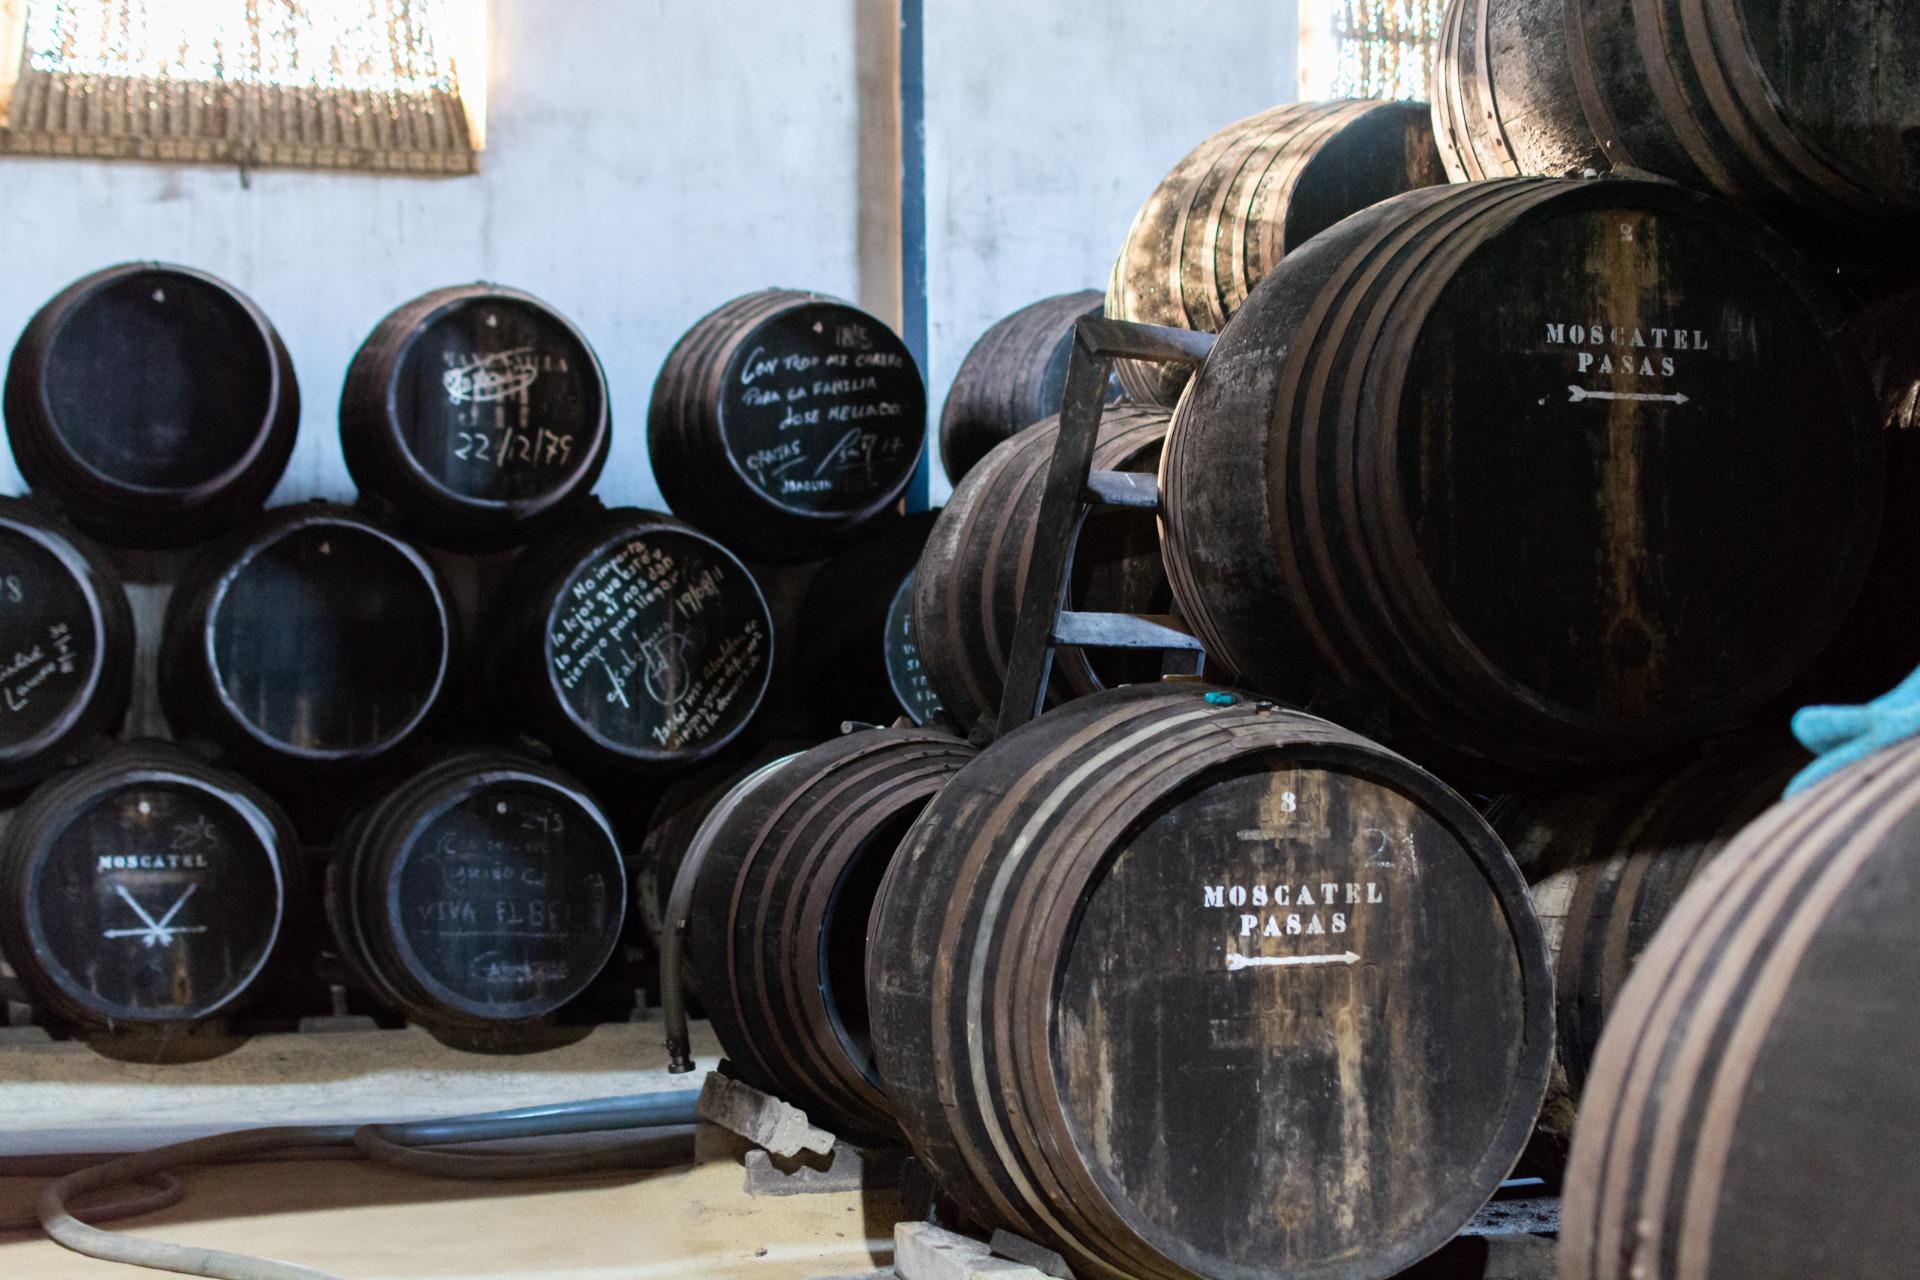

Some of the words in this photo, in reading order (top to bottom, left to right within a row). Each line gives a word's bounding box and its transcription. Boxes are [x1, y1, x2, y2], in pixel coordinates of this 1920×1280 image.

[1546, 323, 1708, 350] MOSCATEL
[1578, 352, 1675, 376] PASAS
[813, 377, 877, 395] FAMILIA
[572, 579, 596, 600] No
[562, 638, 609, 689] tiempo
[609, 608, 637, 641] para
[1281, 791, 1297, 812] 8
[98, 854, 207, 869] MOSCATEL
[1203, 882, 1382, 907] MOSCATEL
[1240, 912, 1347, 937] PASAS
